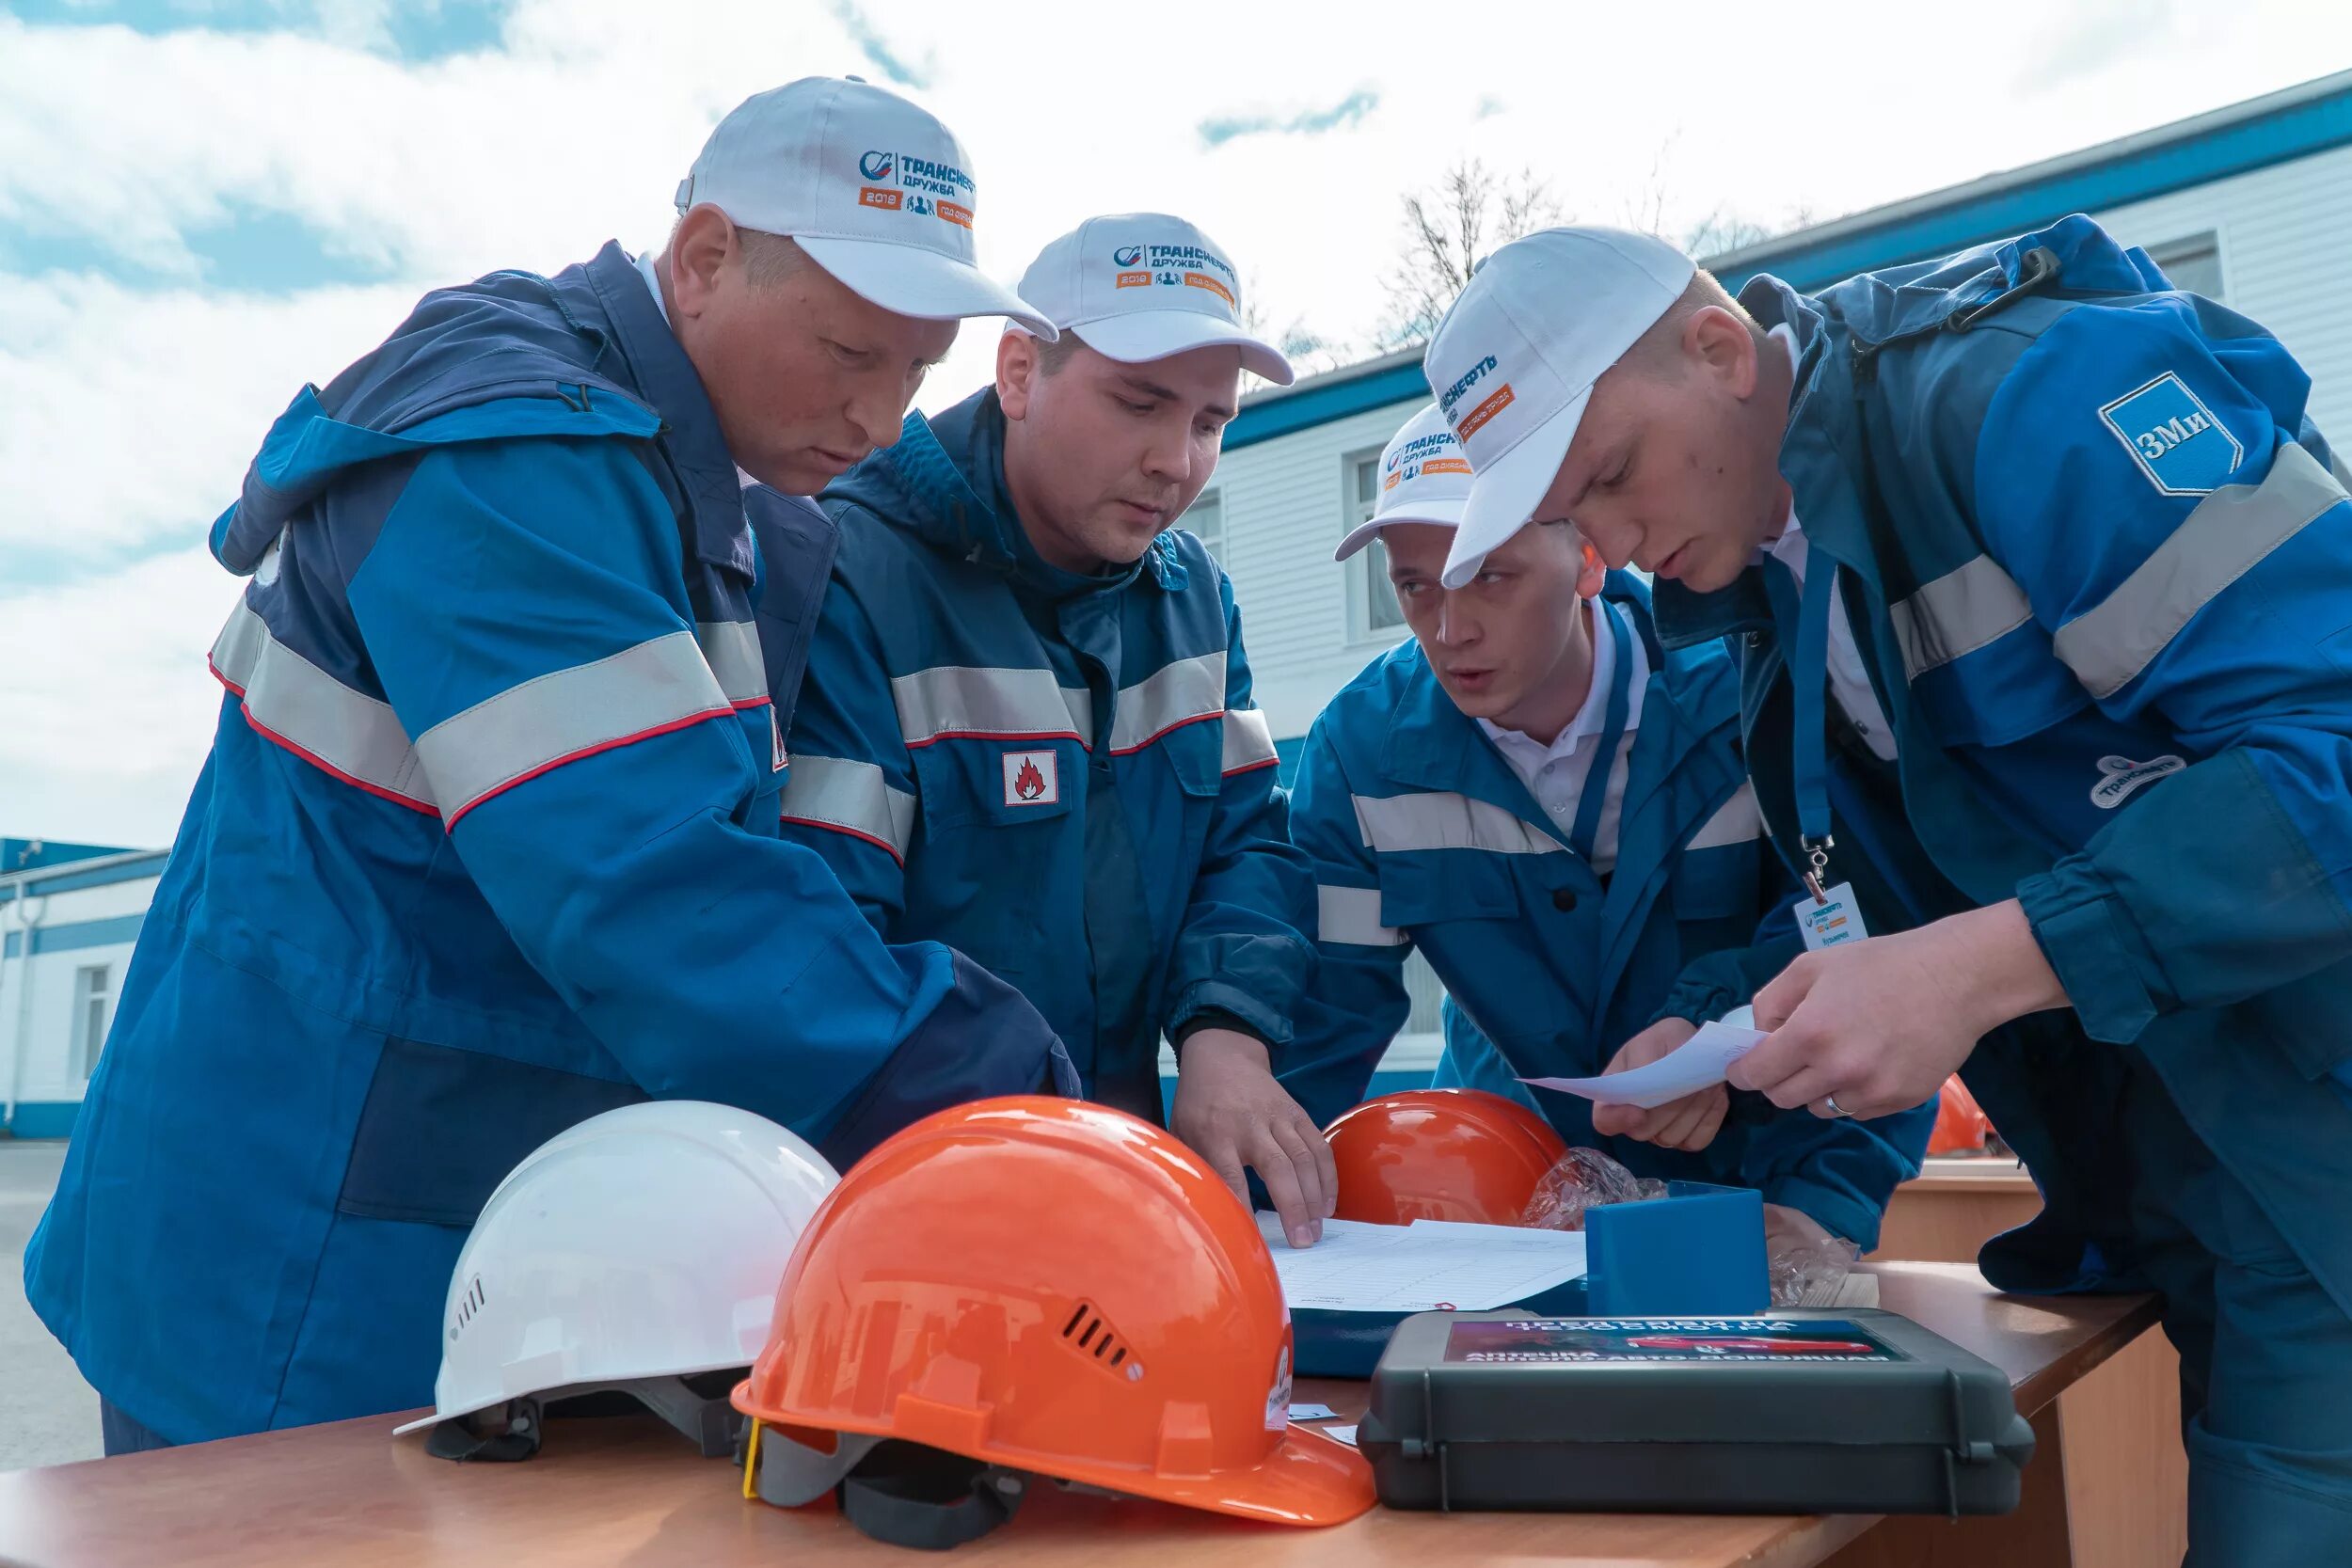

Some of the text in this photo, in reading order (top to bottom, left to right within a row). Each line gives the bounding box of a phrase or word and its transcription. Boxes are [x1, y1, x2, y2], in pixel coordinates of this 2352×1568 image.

[903, 174, 956, 197] ДРУЖБА
[1149, 245, 1235, 283] ТРАНСНЕФТЬ
[1151, 258, 1203, 270] ДРУЖБА
[1405, 433, 1456, 454] ТРАНСН
[2136, 411, 2212, 460] ЗМи
[1402, 446, 1441, 465] ДРУЖБА
